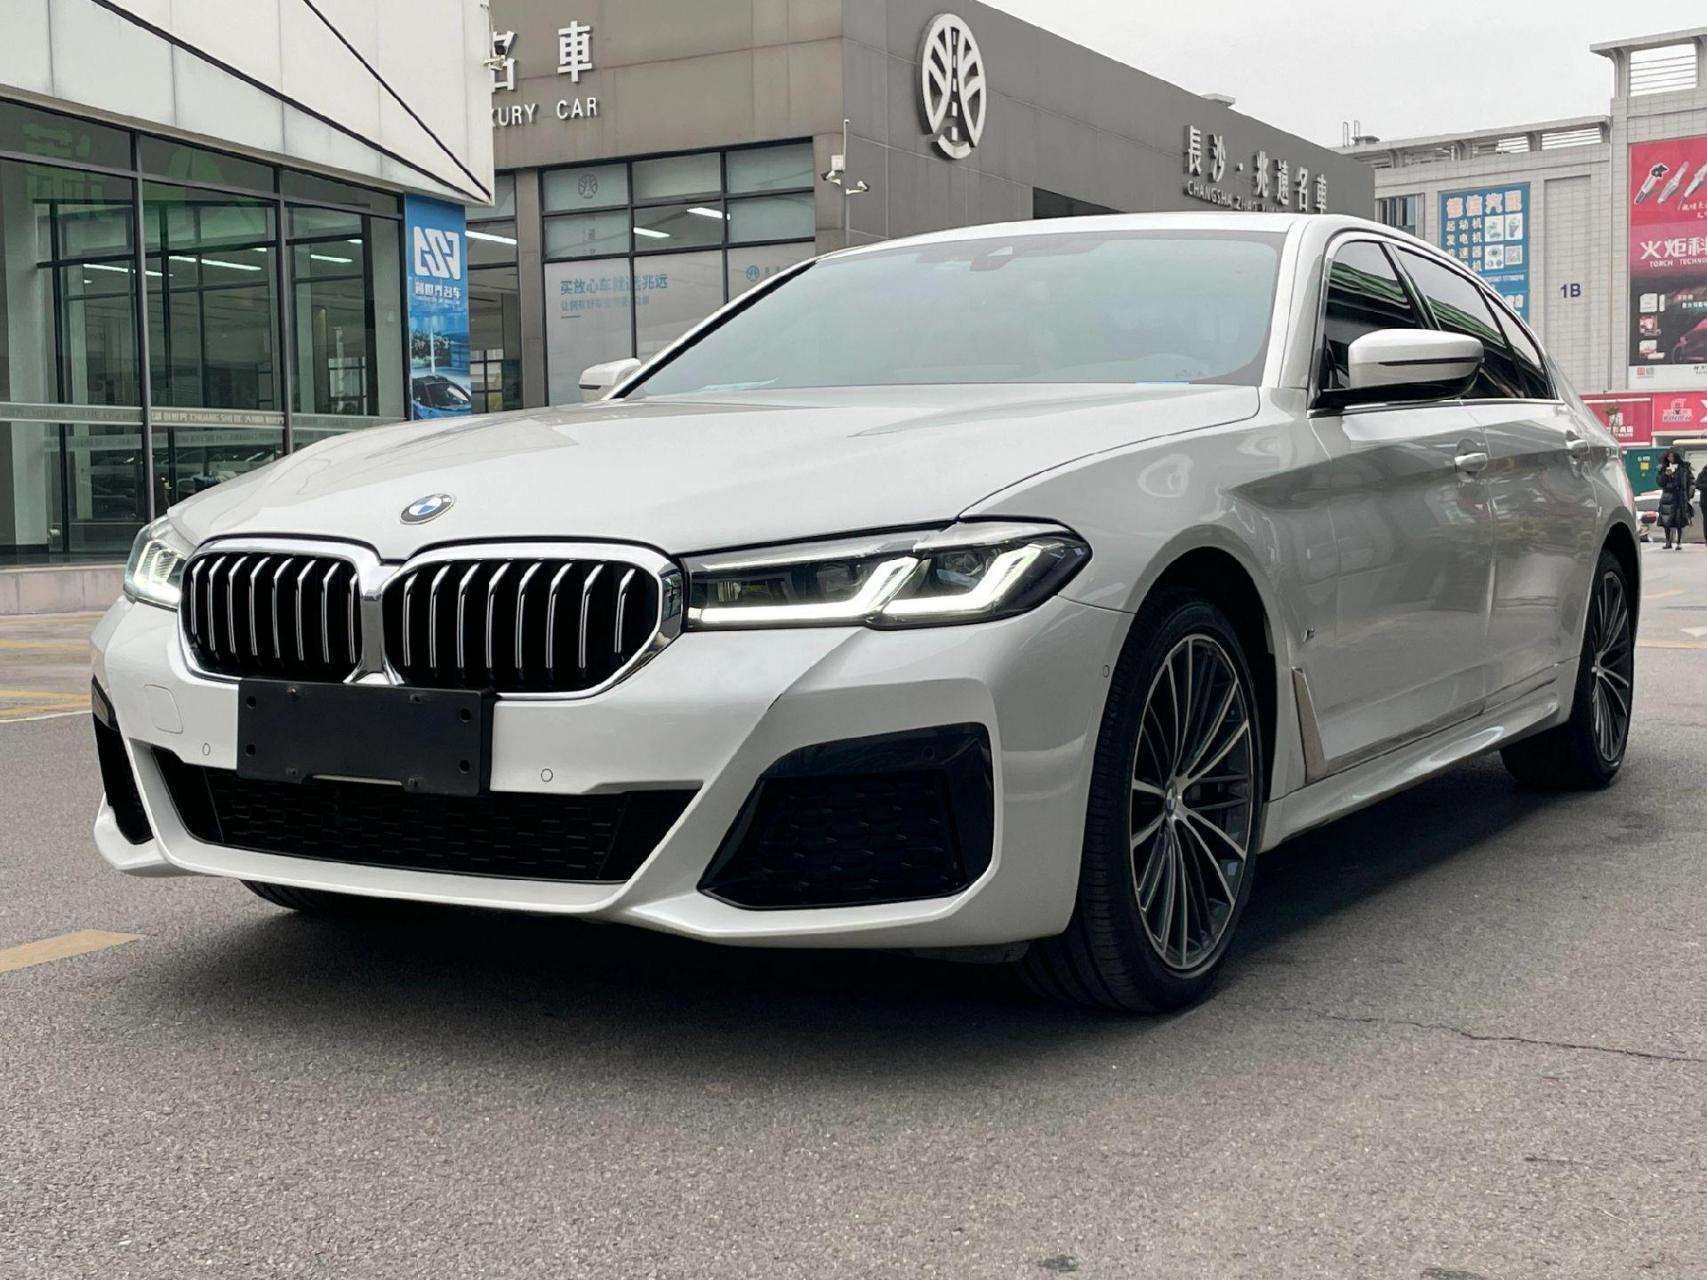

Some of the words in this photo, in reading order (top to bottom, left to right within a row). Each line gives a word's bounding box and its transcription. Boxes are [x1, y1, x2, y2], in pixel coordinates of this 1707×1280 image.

[556, 97, 597, 120] CAR
[1187, 180, 1233, 205] CHANGSHA
[1649, 260, 1674, 268] TORCH
[1560, 282, 1582, 299] 1B
